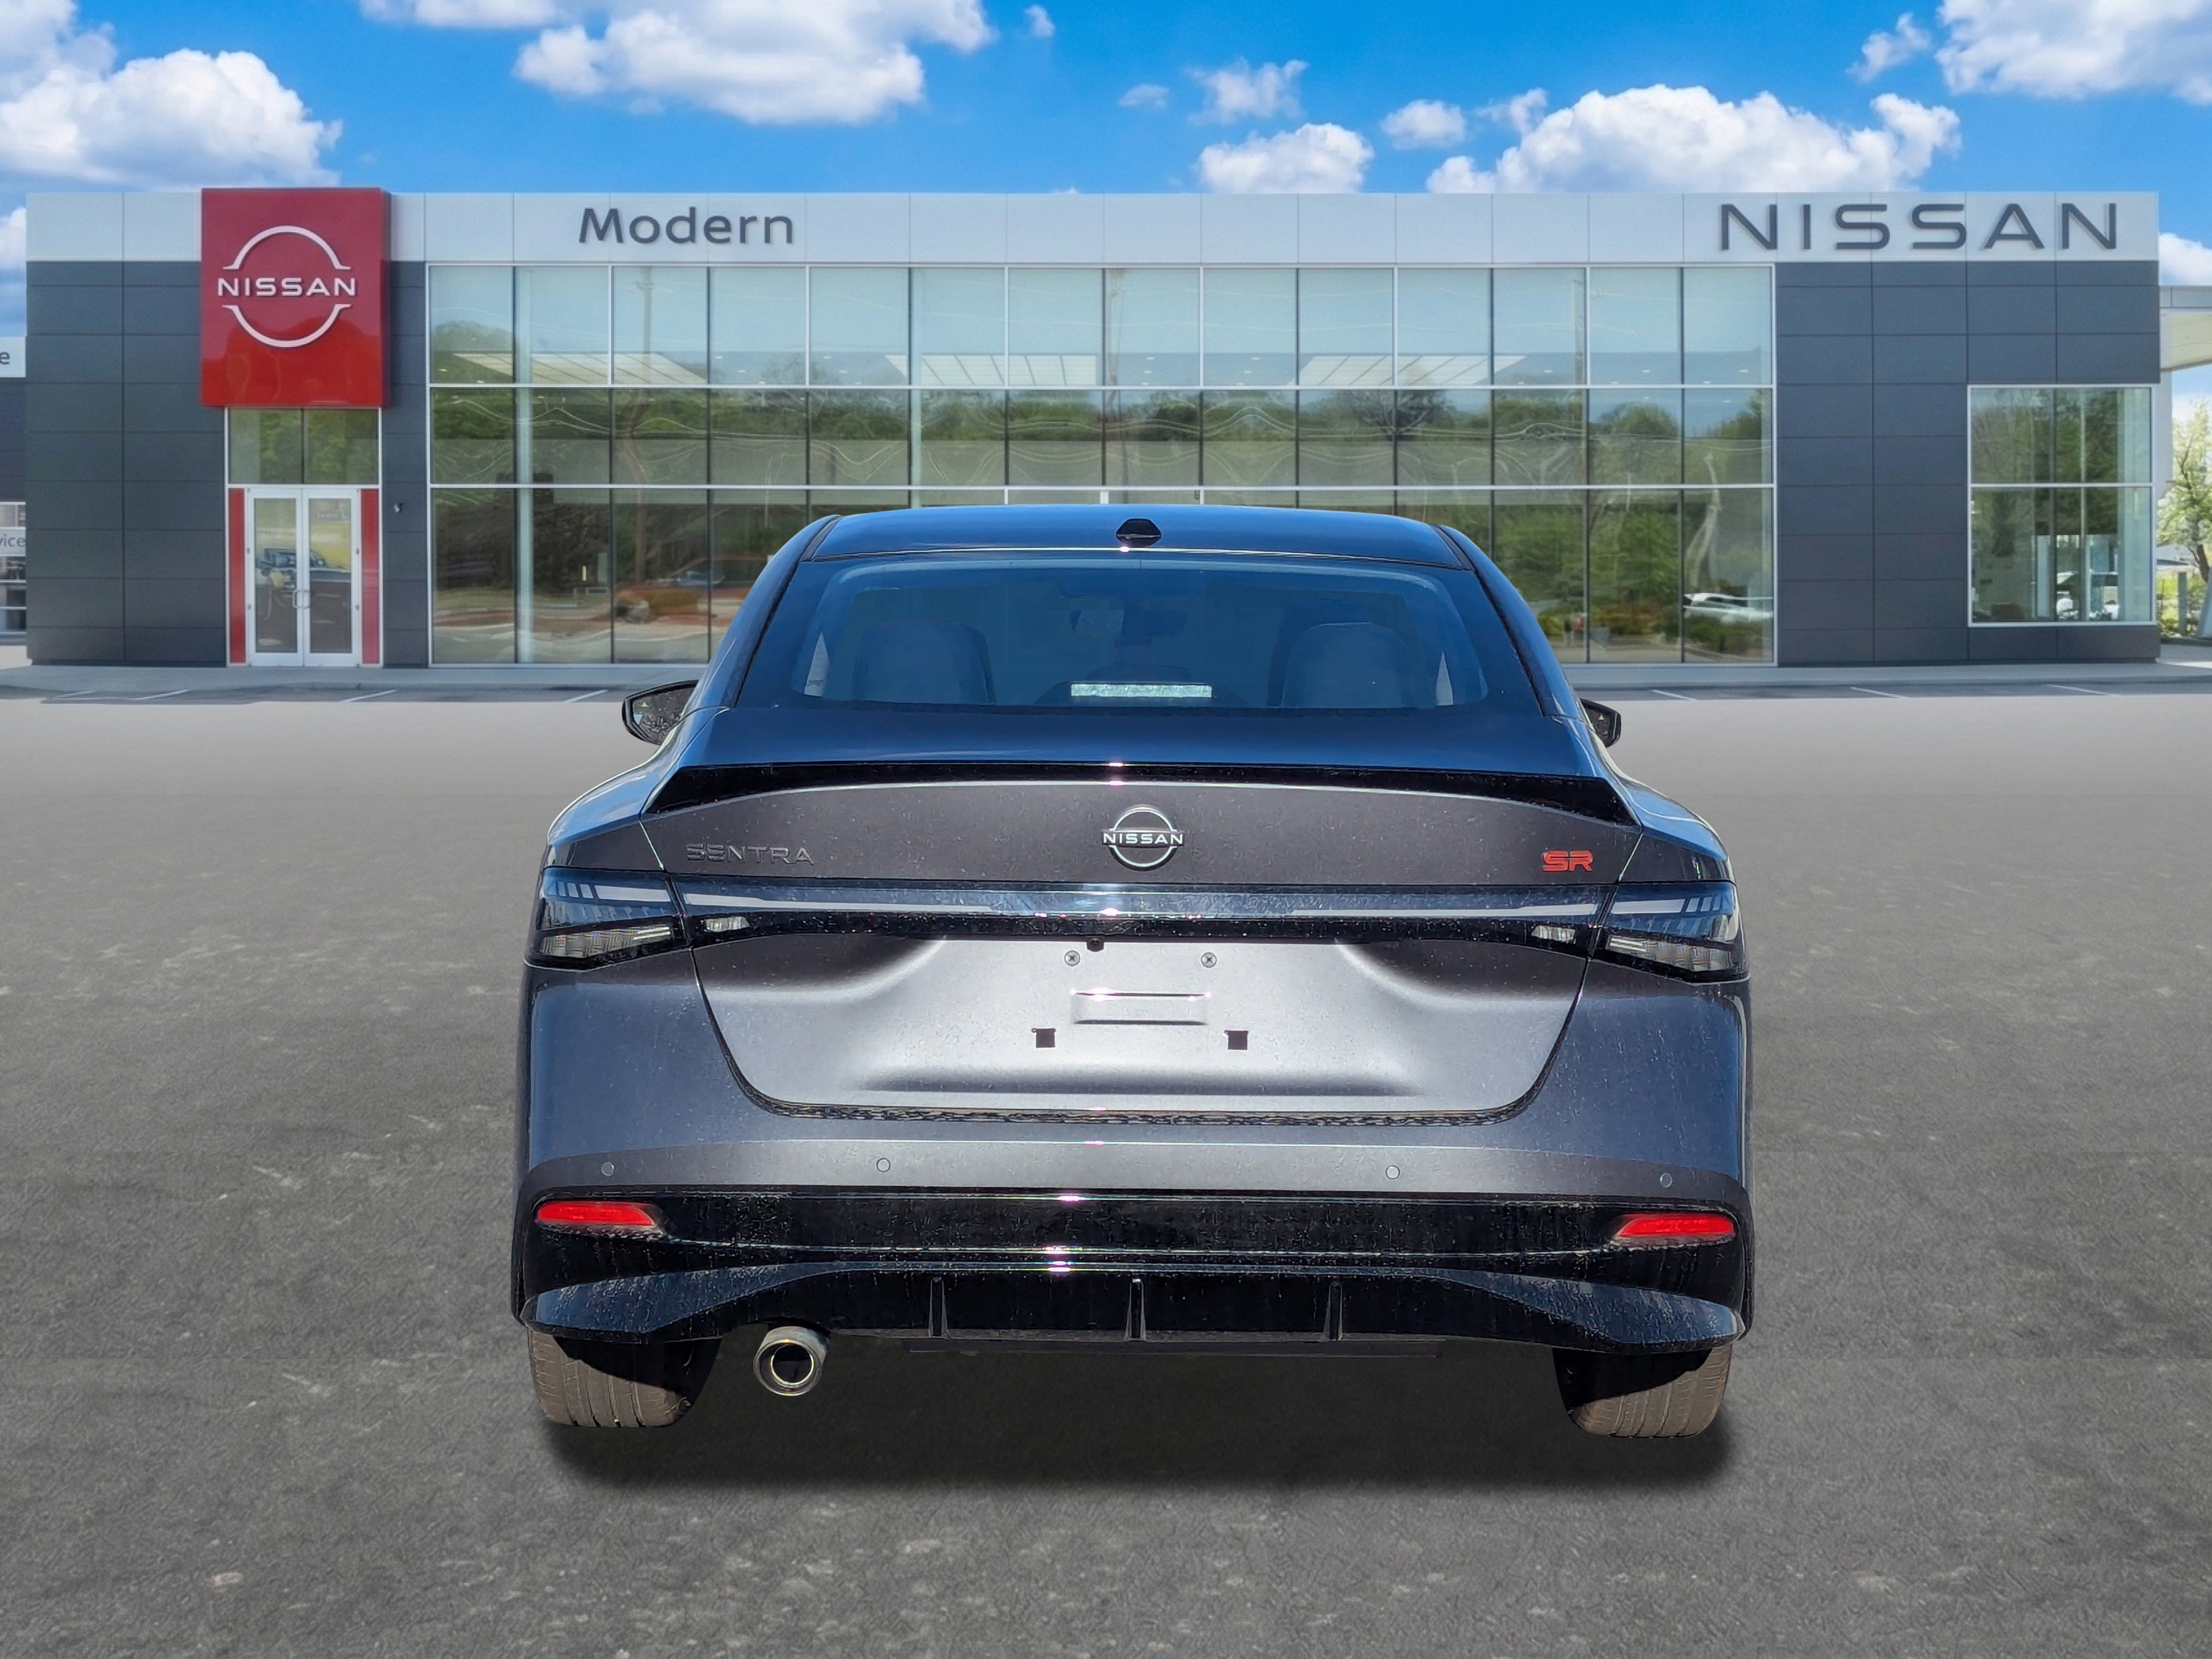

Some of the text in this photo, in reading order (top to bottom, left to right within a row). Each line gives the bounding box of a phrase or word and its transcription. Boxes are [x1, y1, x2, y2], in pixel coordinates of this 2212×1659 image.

[579, 207, 793, 243] Modern
[1721, 203, 2117, 249] NISSAN
[218, 277, 356, 297] NISSAN
[1103, 833, 1183, 845] NISSAN
[686, 844, 814, 865] SENTRA
[1542, 850, 1593, 871] SR
